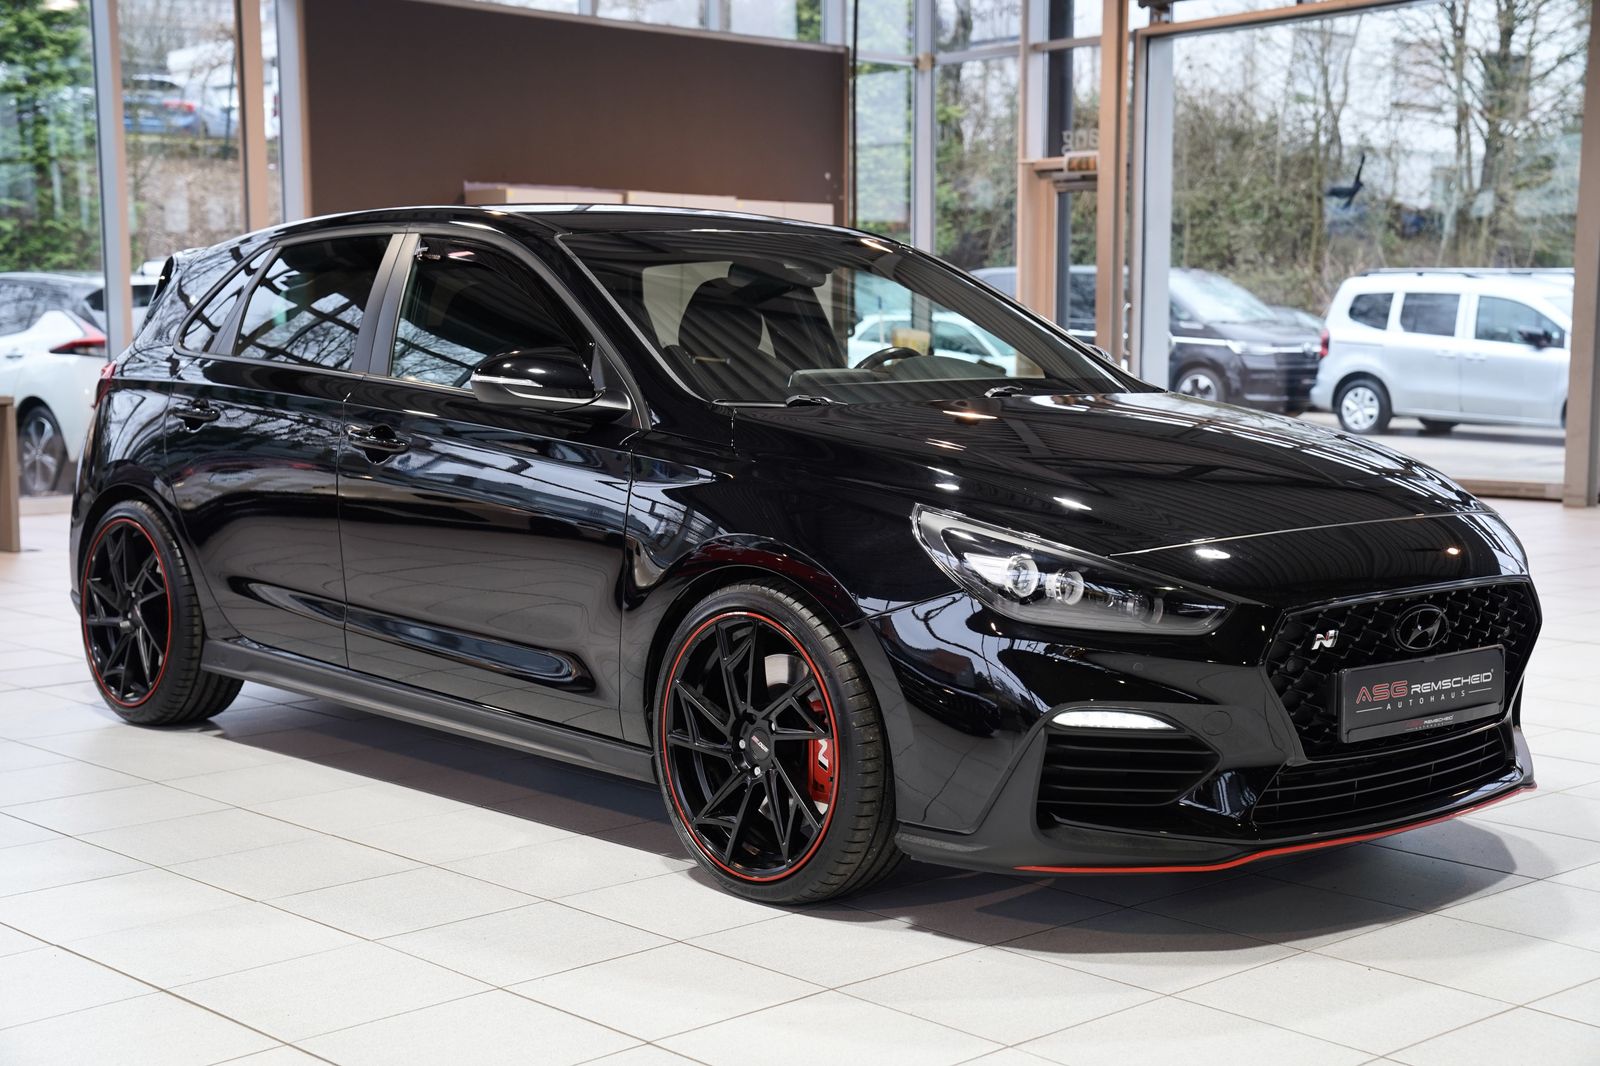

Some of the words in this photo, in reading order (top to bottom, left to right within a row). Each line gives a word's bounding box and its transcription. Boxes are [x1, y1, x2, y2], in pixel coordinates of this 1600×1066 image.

[1311, 629, 1339, 650] N
[1356, 680, 1408, 704] ASG
[1386, 690, 1466, 710] AUTOHAUS
